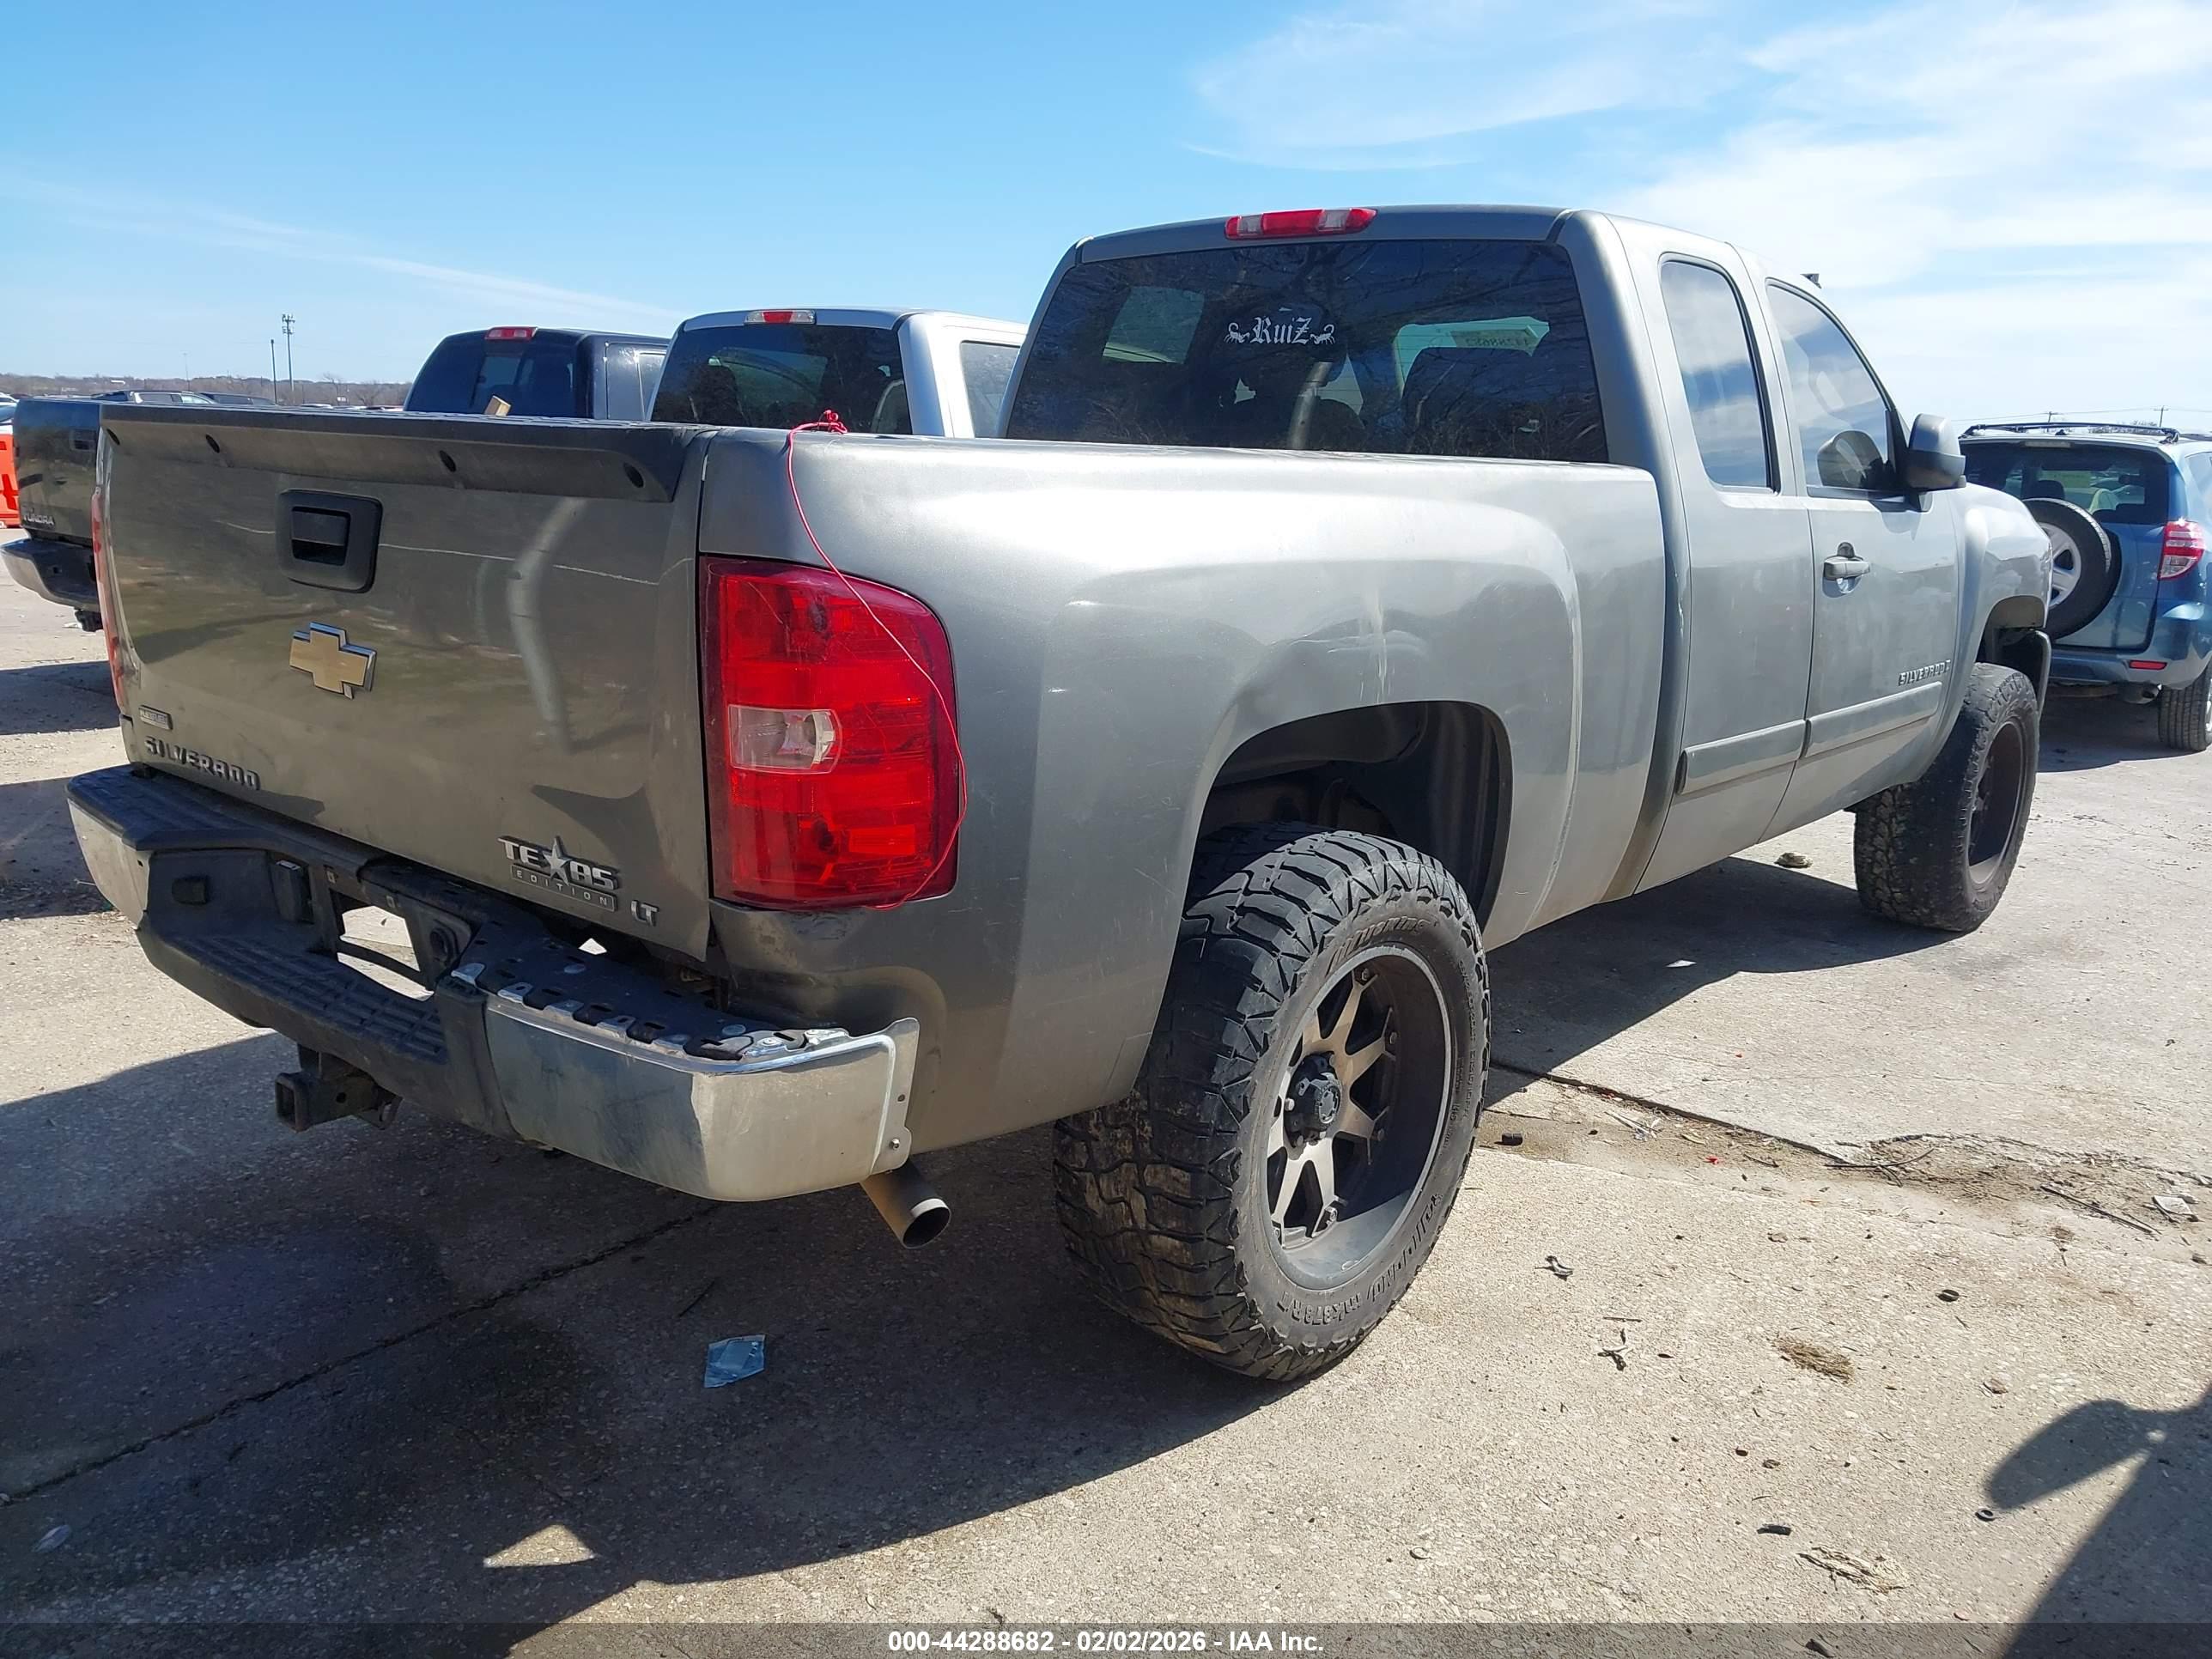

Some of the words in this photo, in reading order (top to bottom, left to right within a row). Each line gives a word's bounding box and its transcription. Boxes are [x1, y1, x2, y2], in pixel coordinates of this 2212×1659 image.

[23, 514, 55, 526] TUNDRA
[1898, 661, 1948, 686] SILVERADO
[144, 736, 261, 791] SILVERADO
[515, 869, 608, 907] EDITION
[630, 900, 659, 927] LT
